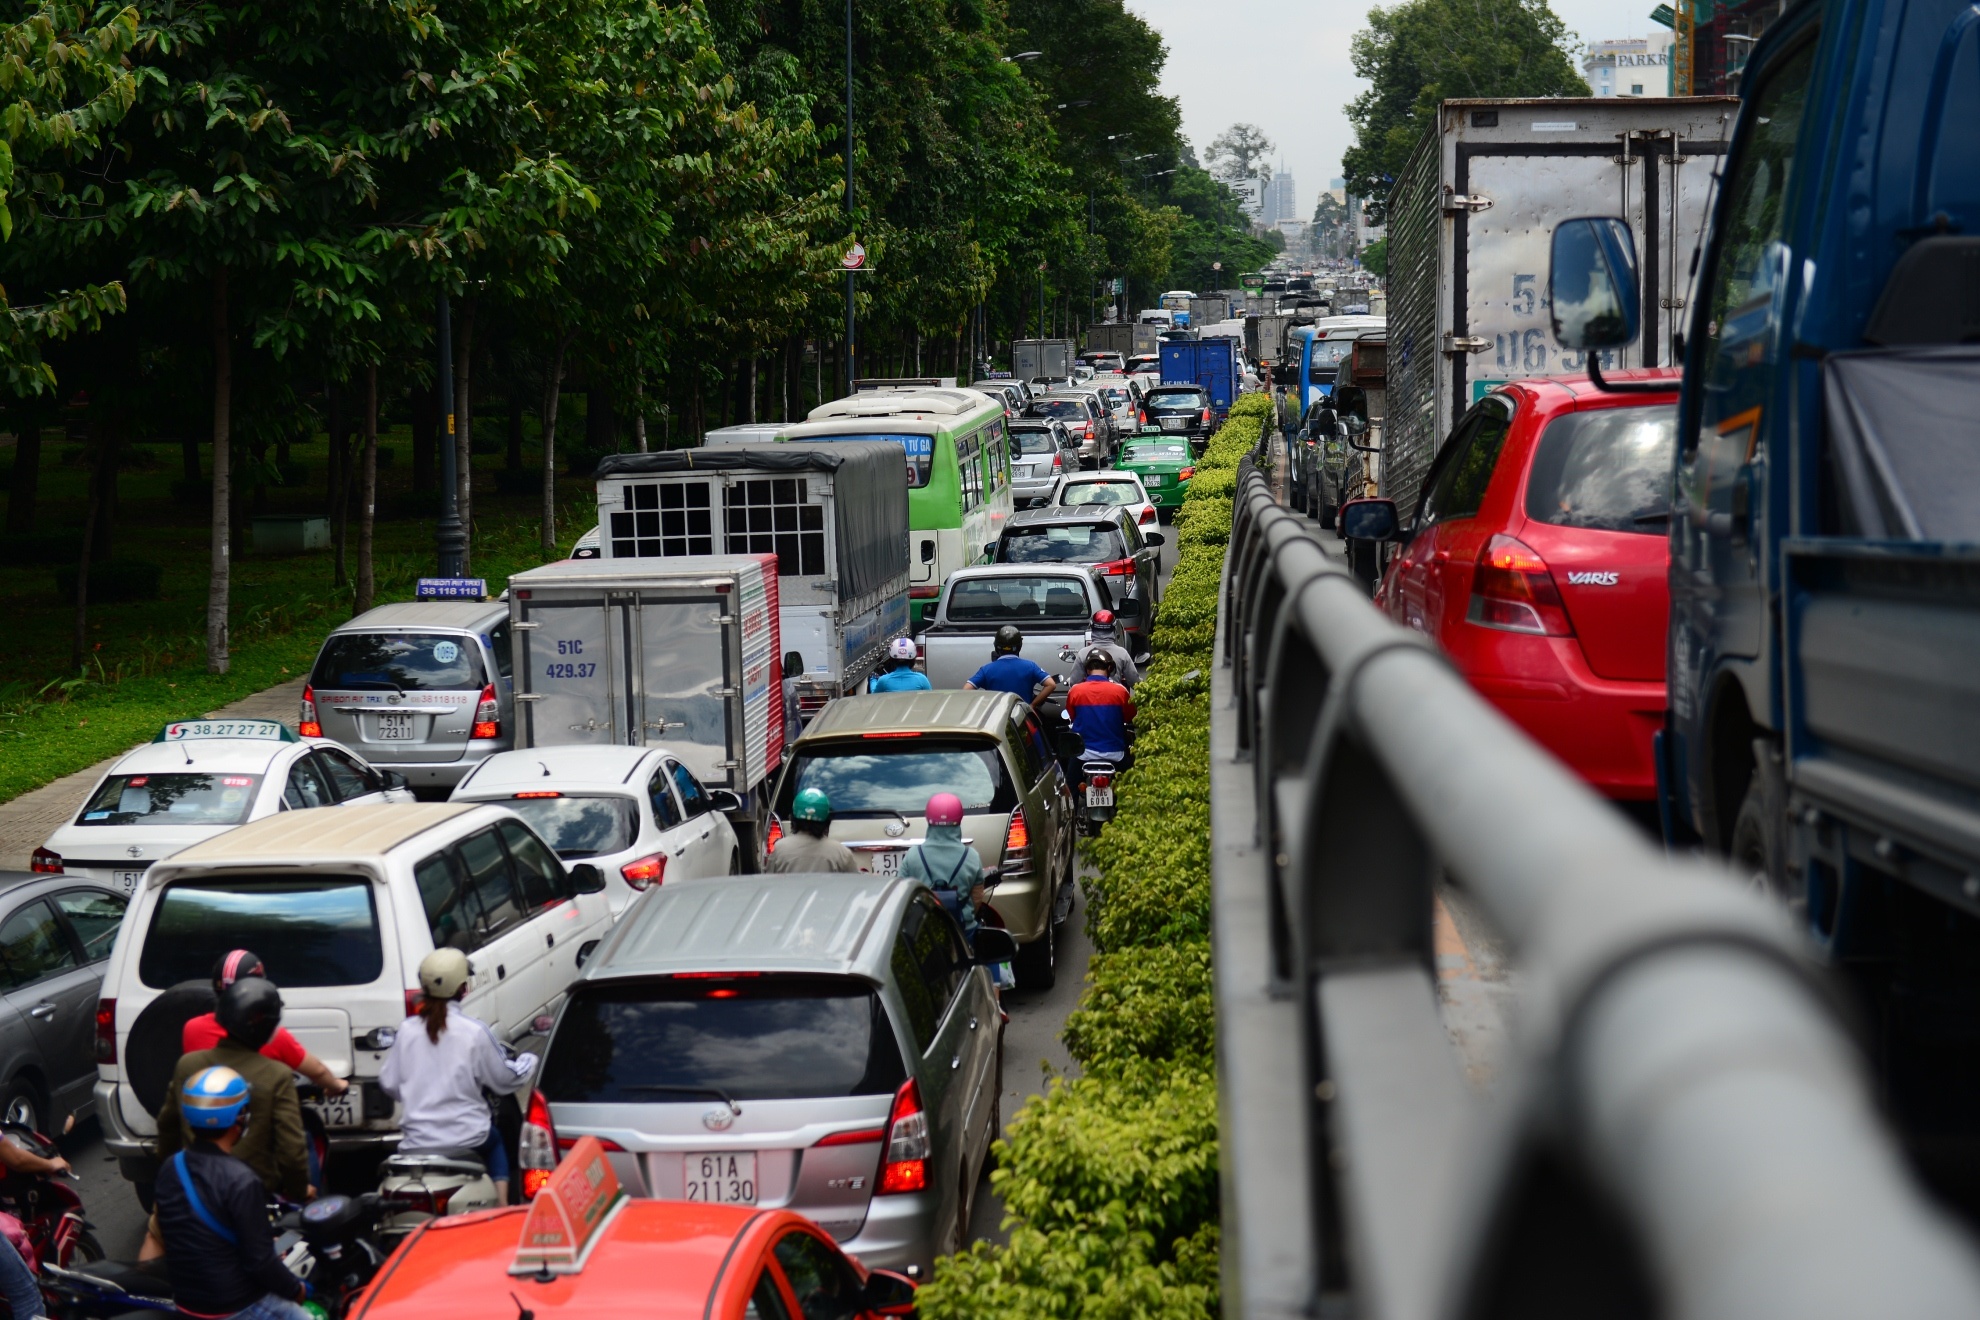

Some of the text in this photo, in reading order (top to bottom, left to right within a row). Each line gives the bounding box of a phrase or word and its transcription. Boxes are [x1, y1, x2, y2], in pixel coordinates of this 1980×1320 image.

[908, 437, 918, 452] TƯ
[920, 439, 931, 452] GA
[1567, 571, 1619, 586] YARIS
[421, 587, 478, 595] 38 118 118
[557, 640, 583, 655] 51C
[546, 662, 597, 678] 429.37
[386, 715, 406, 727] 51A
[238, 724, 255, 735] 27
[259, 725, 276, 735] 27
[379, 727, 411, 739] 723.11
[701, 1157, 739, 1179] 61A
[687, 1180, 754, 1202] 211.30
